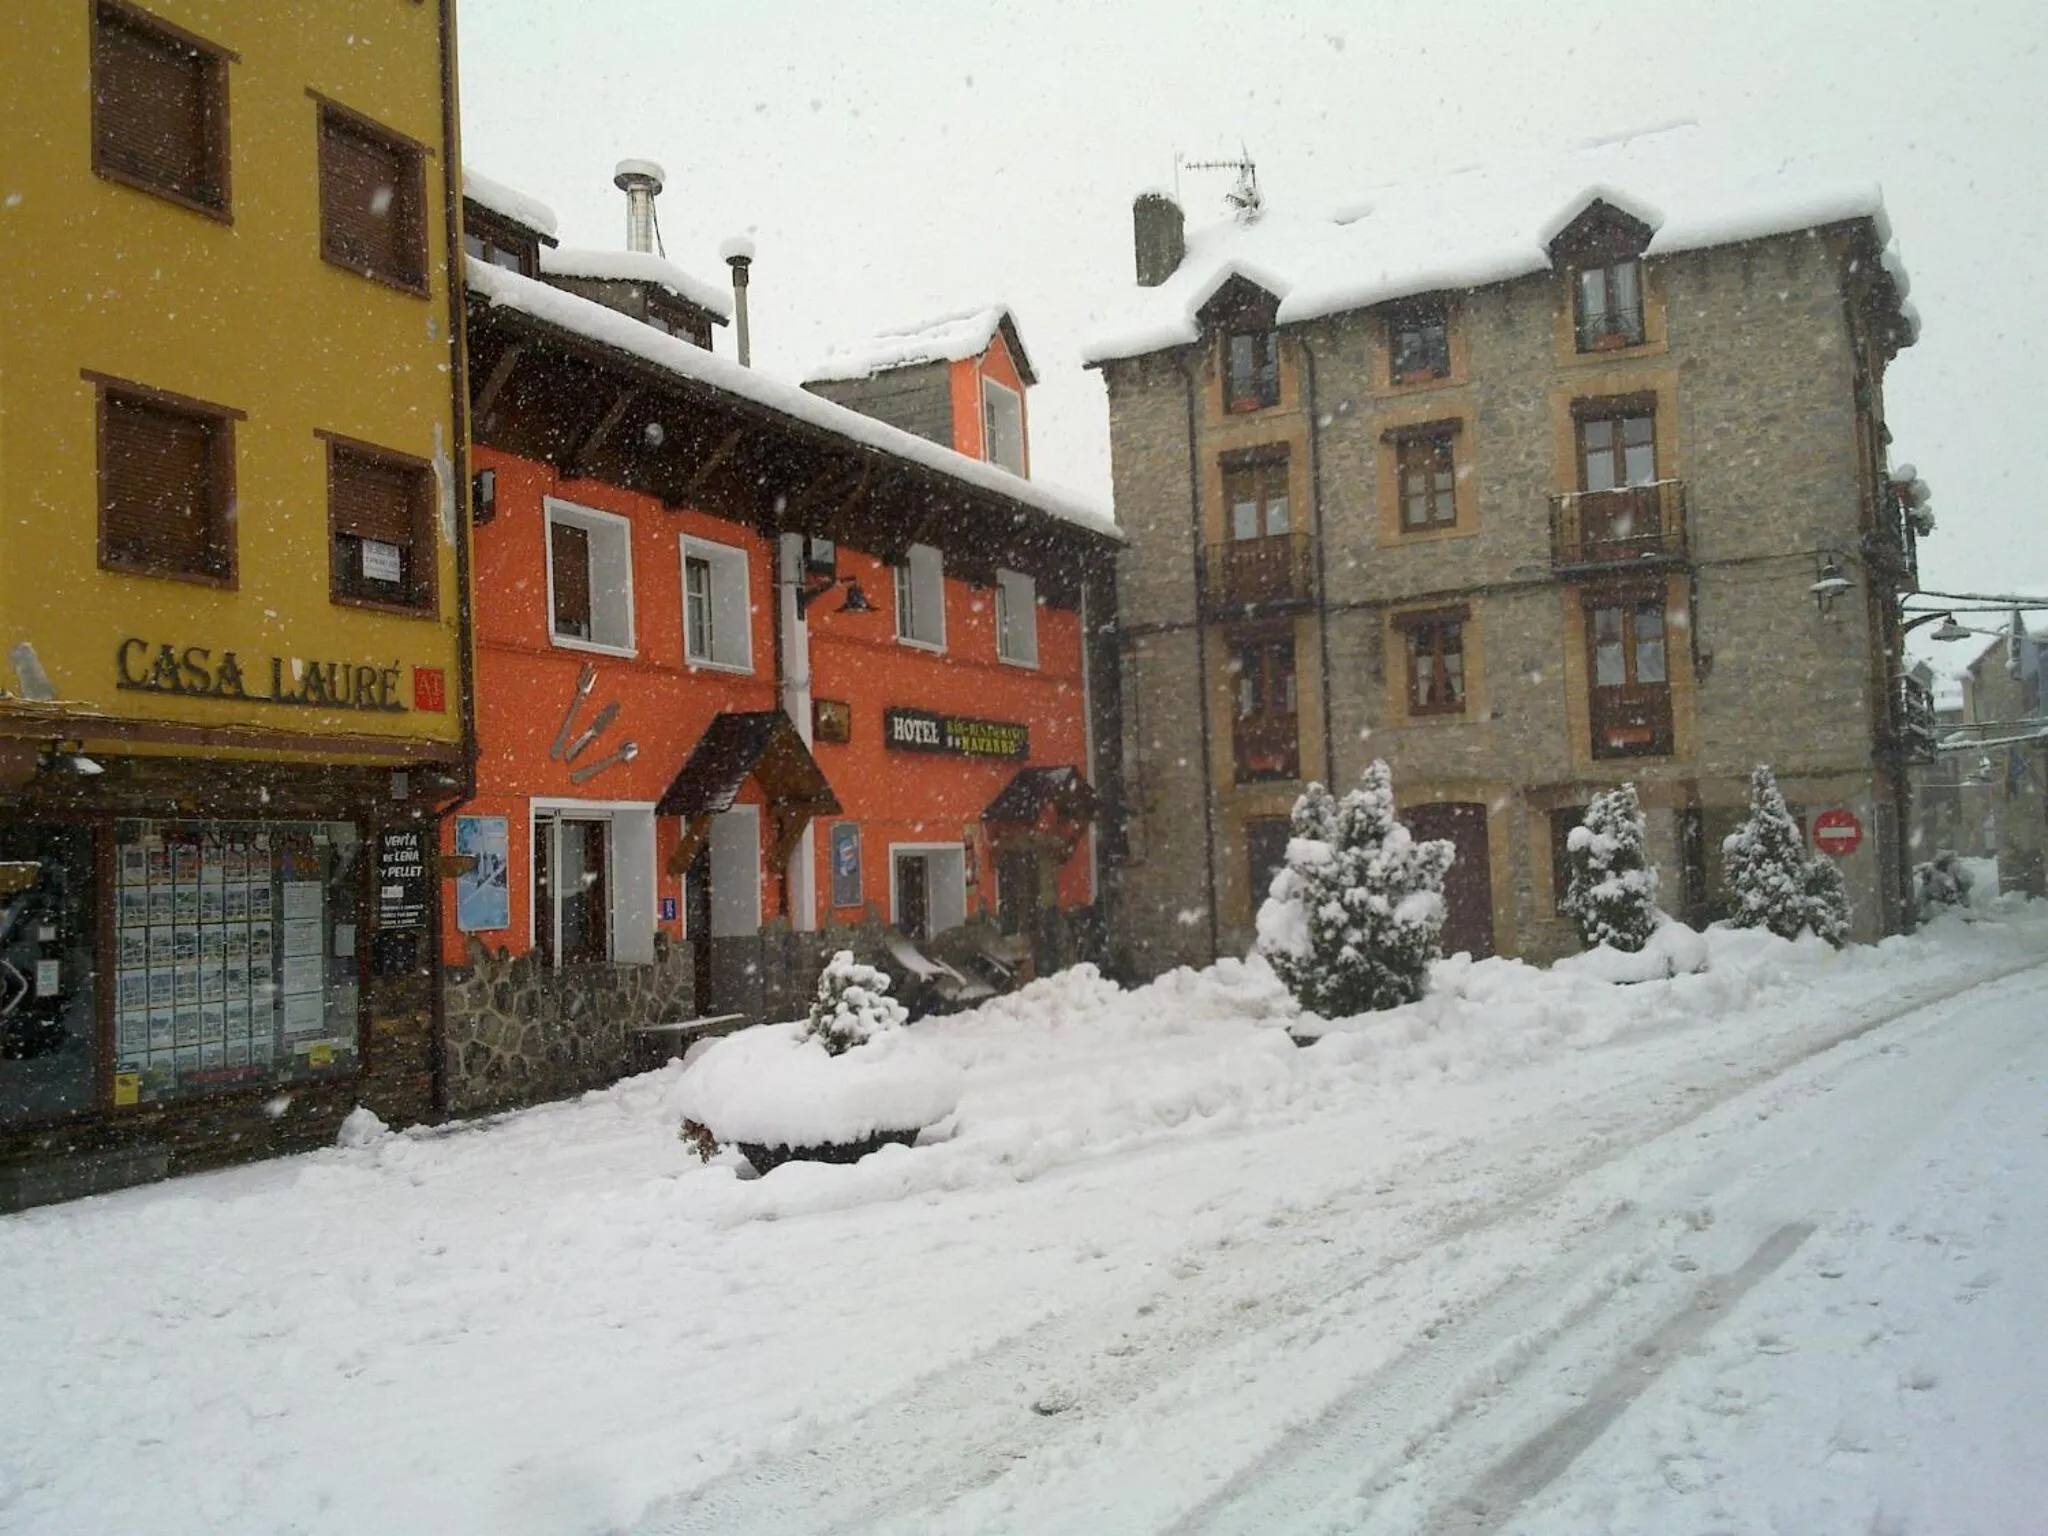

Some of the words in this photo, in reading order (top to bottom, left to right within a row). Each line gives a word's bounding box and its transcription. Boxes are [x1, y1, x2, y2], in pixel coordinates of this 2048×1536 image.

[116, 638, 245, 701] CASA
[271, 657, 409, 713] LAURÉ
[893, 716, 940, 744] HOTEL
[384, 832, 418, 847] VENTA
[395, 847, 419, 862] LEÑA
[387, 866, 423, 877] PELLET
